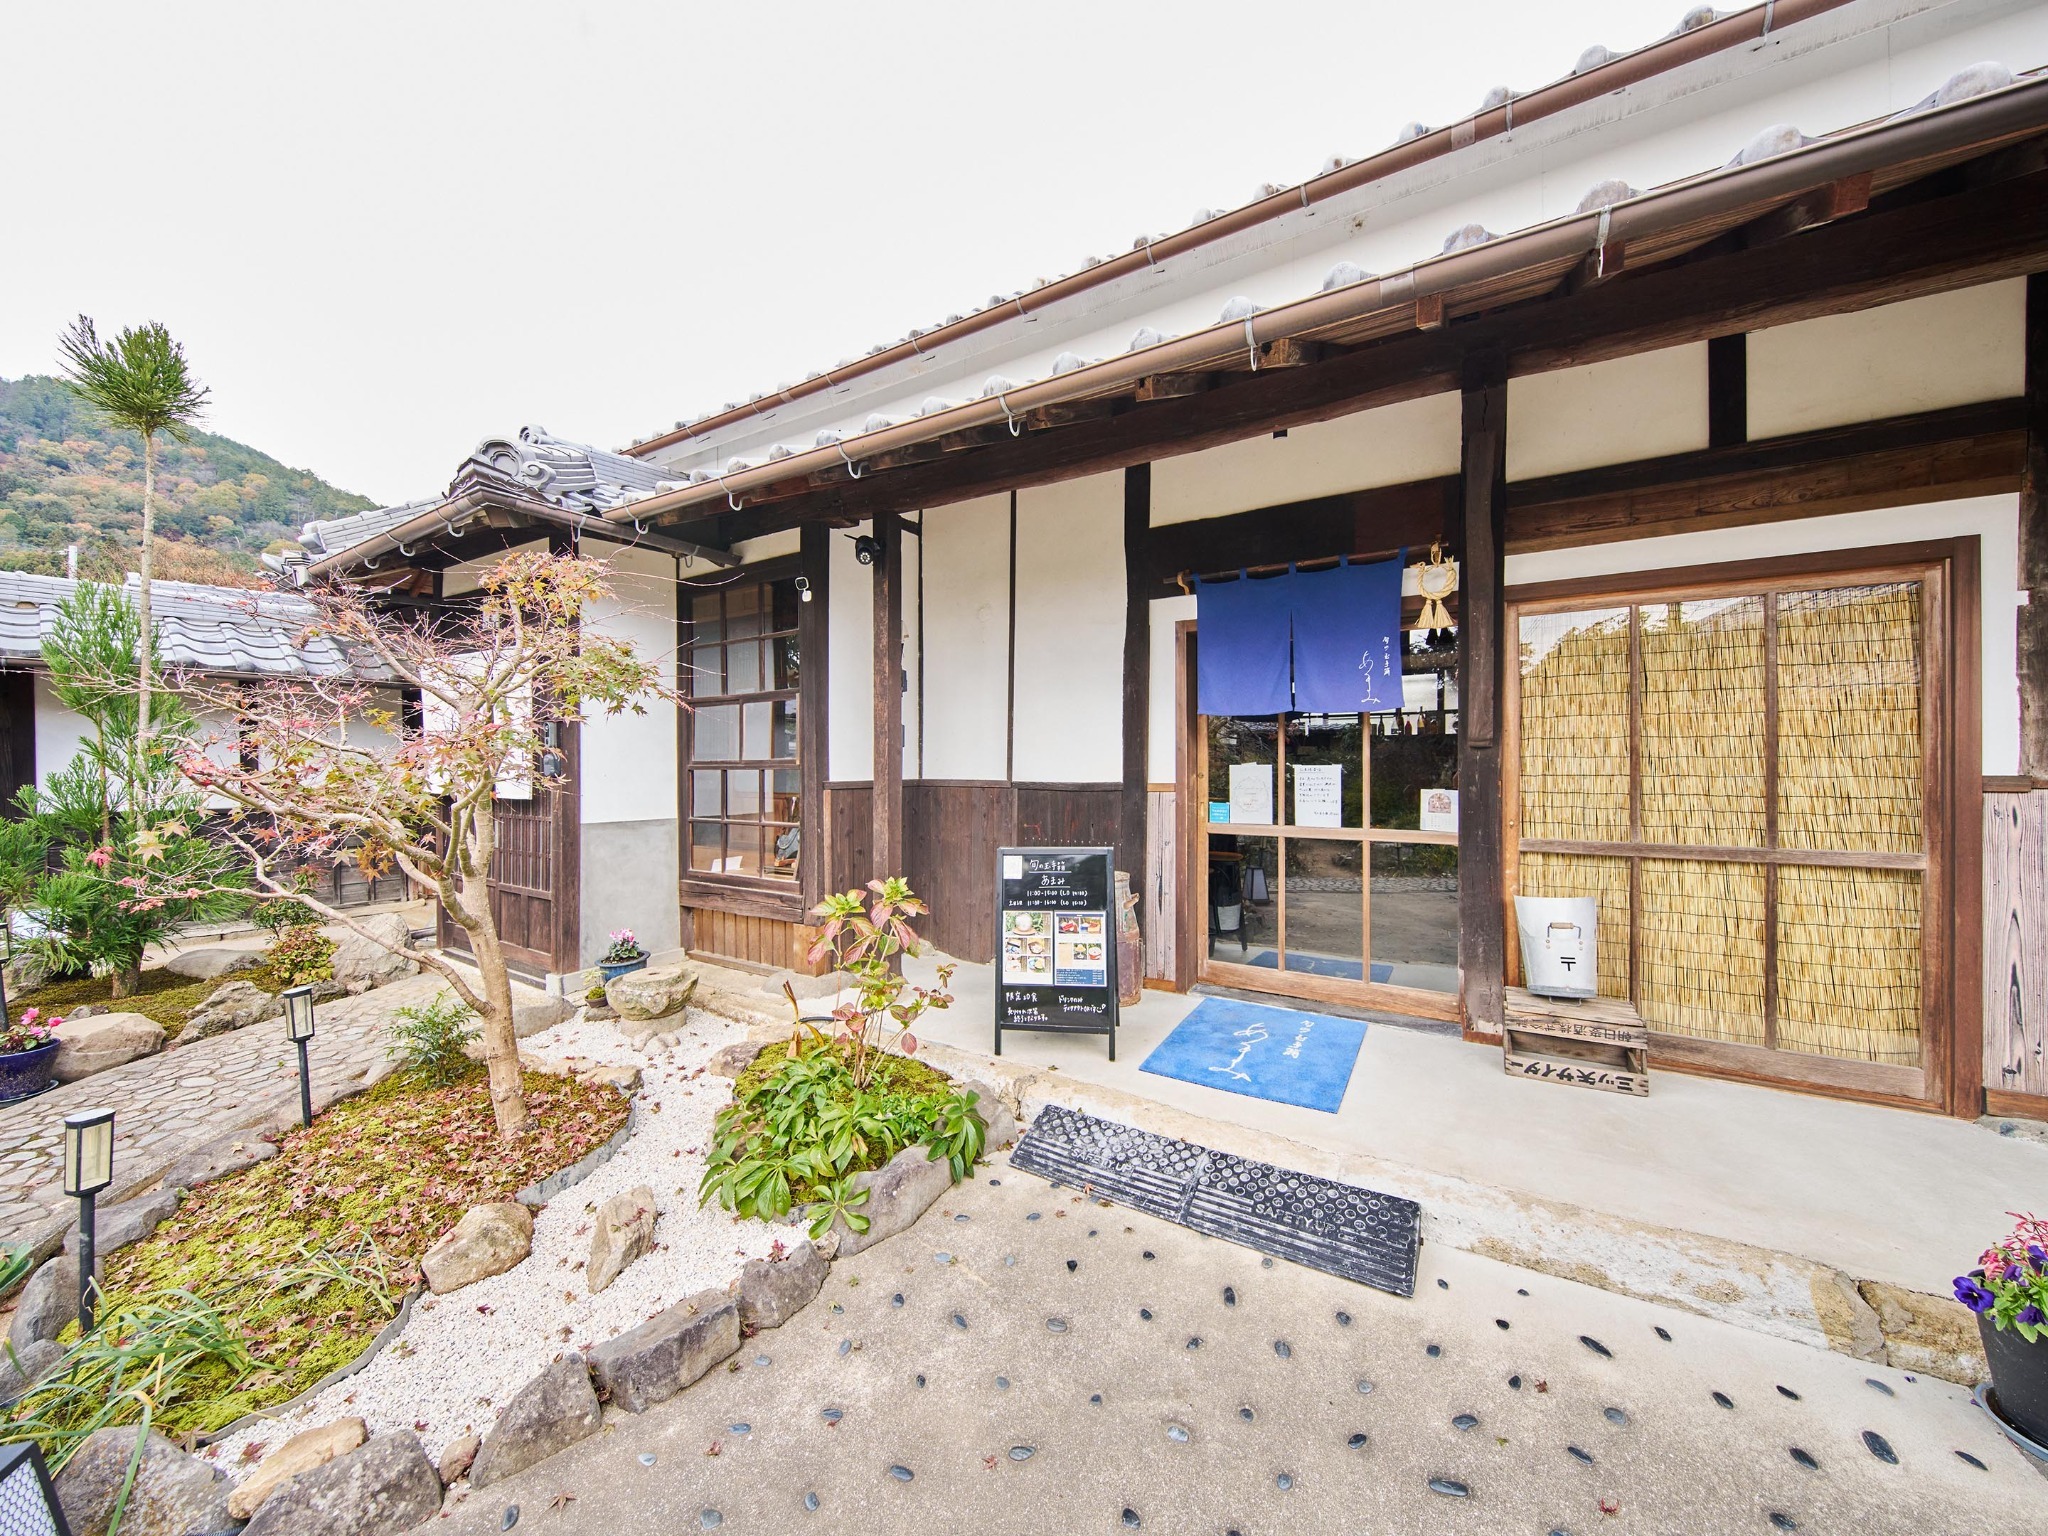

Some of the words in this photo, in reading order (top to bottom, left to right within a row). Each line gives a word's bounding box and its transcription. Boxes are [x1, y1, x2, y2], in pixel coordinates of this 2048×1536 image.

[1041, 875, 1065, 886] あまみ
[1510, 1061, 1634, 1092] 三ツ矢サイダー
